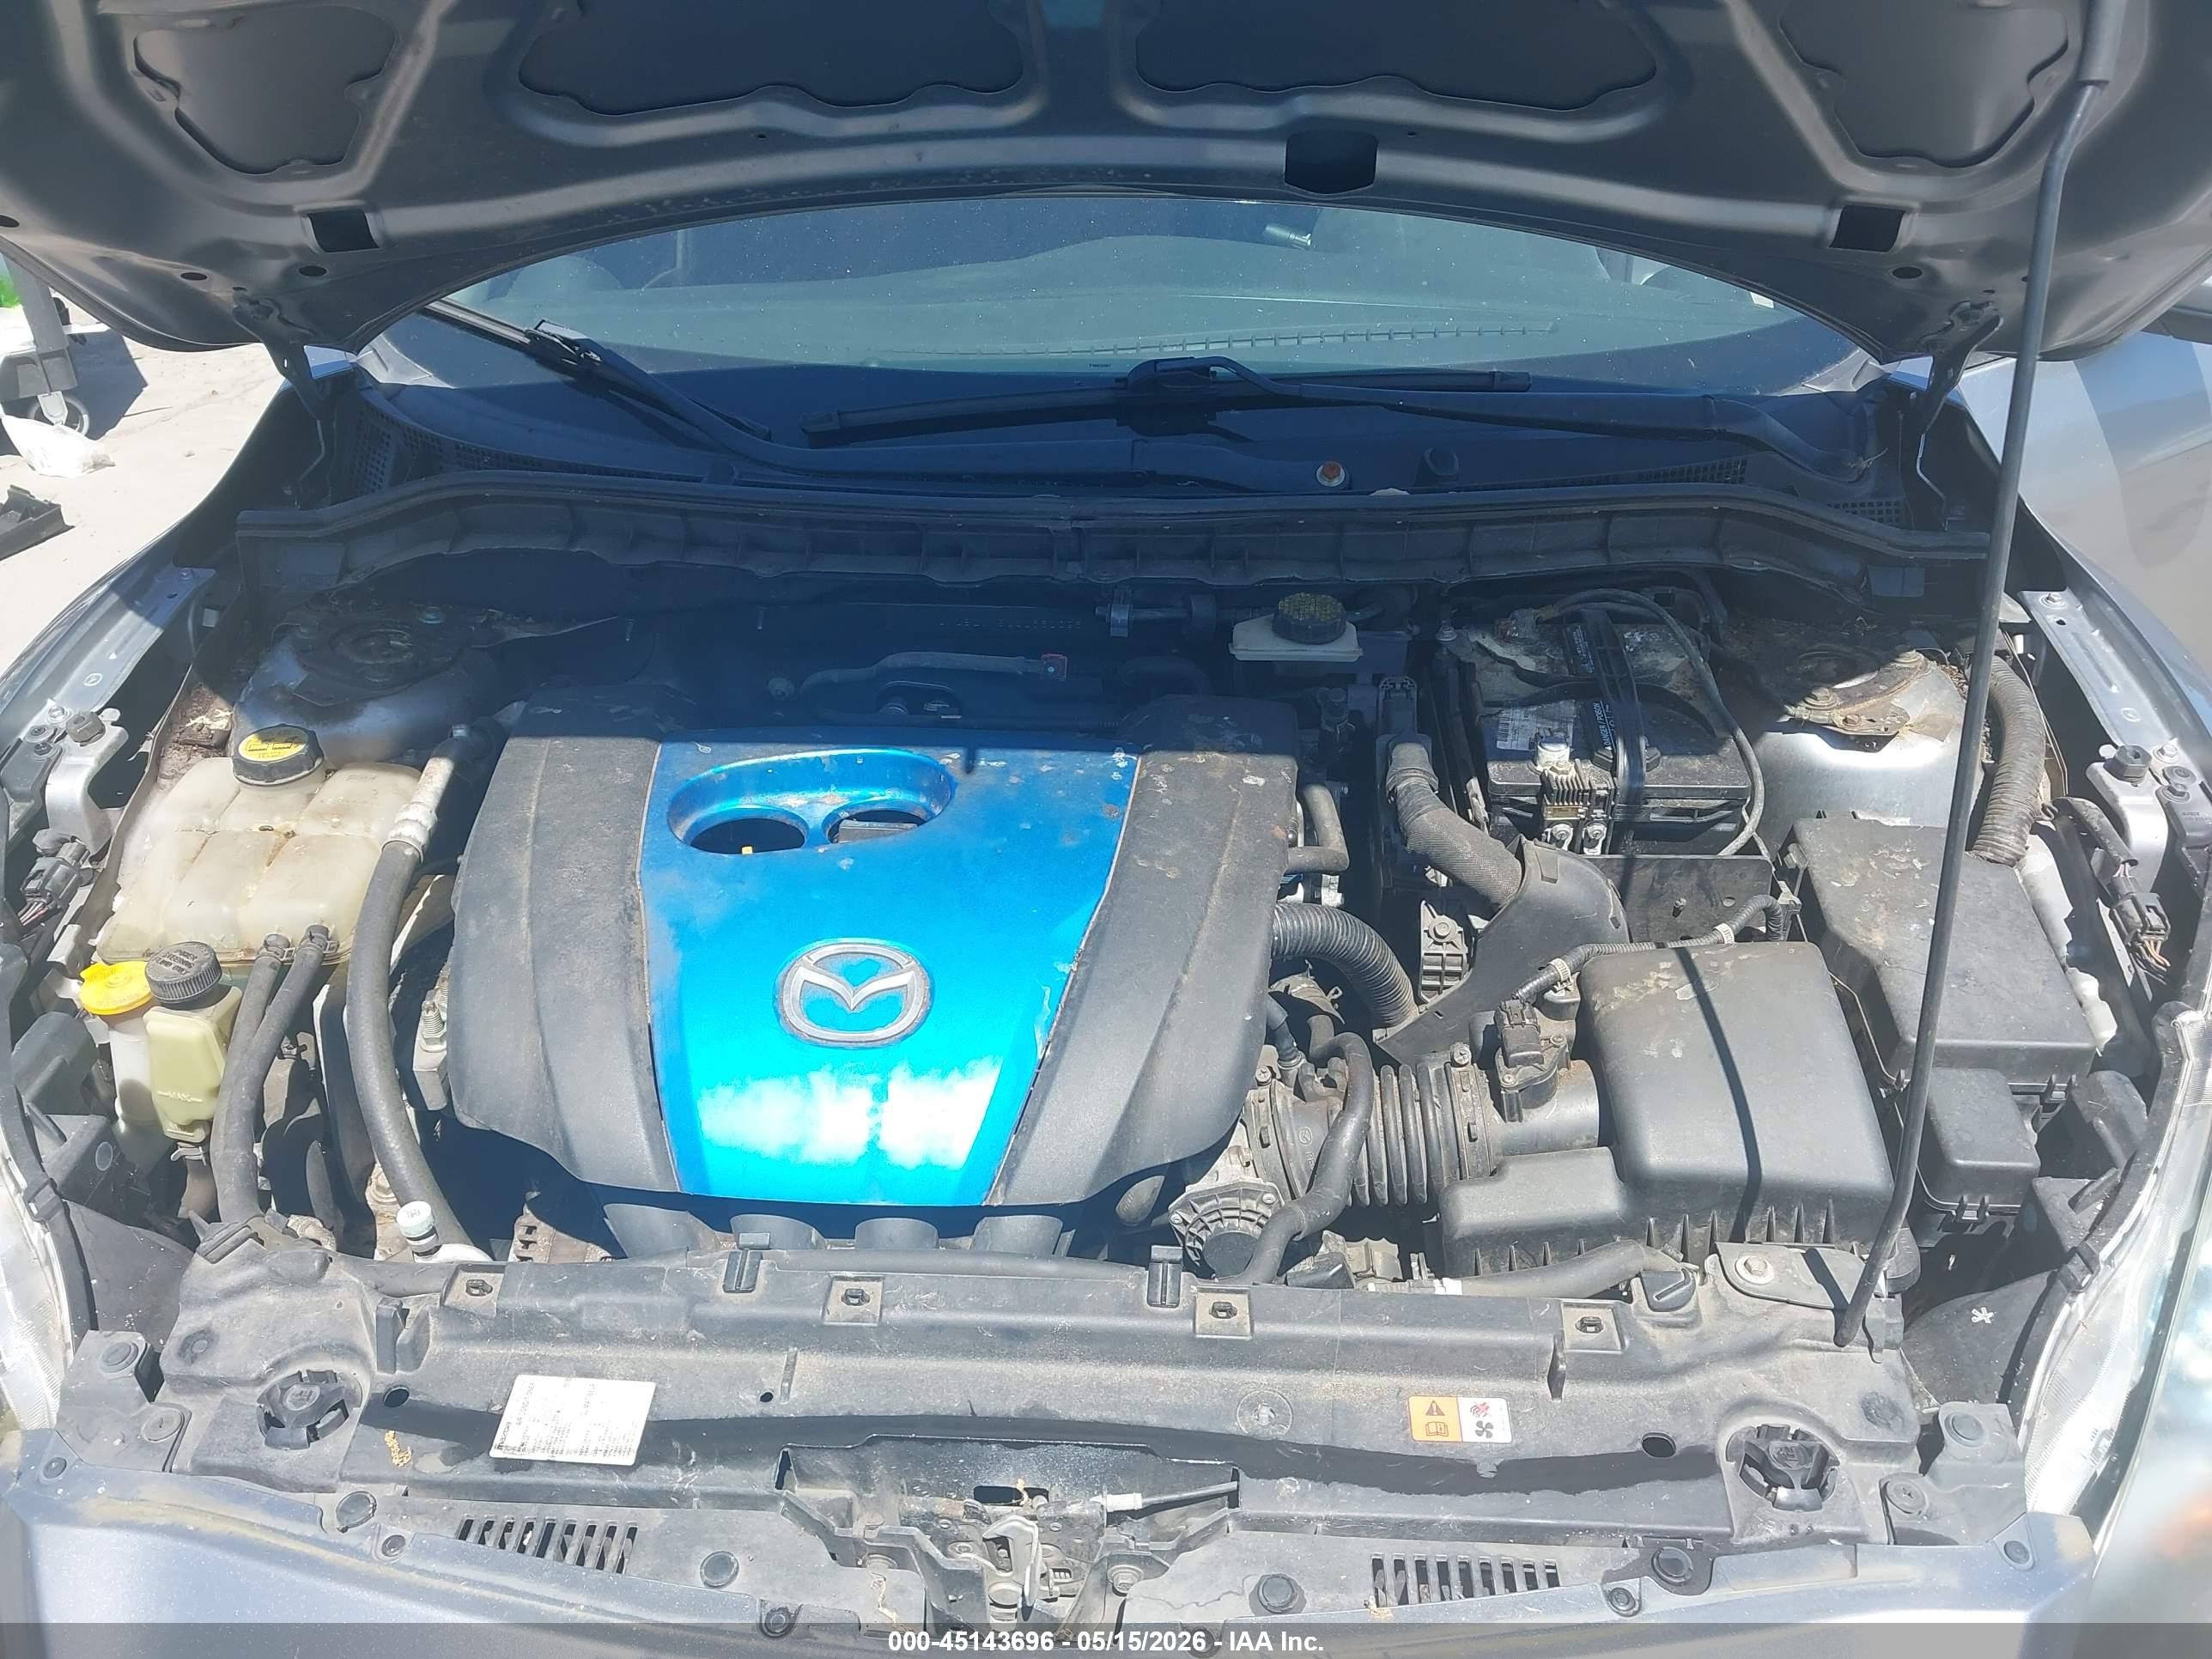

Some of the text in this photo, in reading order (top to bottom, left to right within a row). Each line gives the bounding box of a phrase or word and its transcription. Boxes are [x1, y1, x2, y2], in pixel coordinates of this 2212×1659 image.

[1593, 702, 1605, 720] POISON
[1599, 725, 1612, 745] DANGER
[172, 963, 191, 976] ONLY
